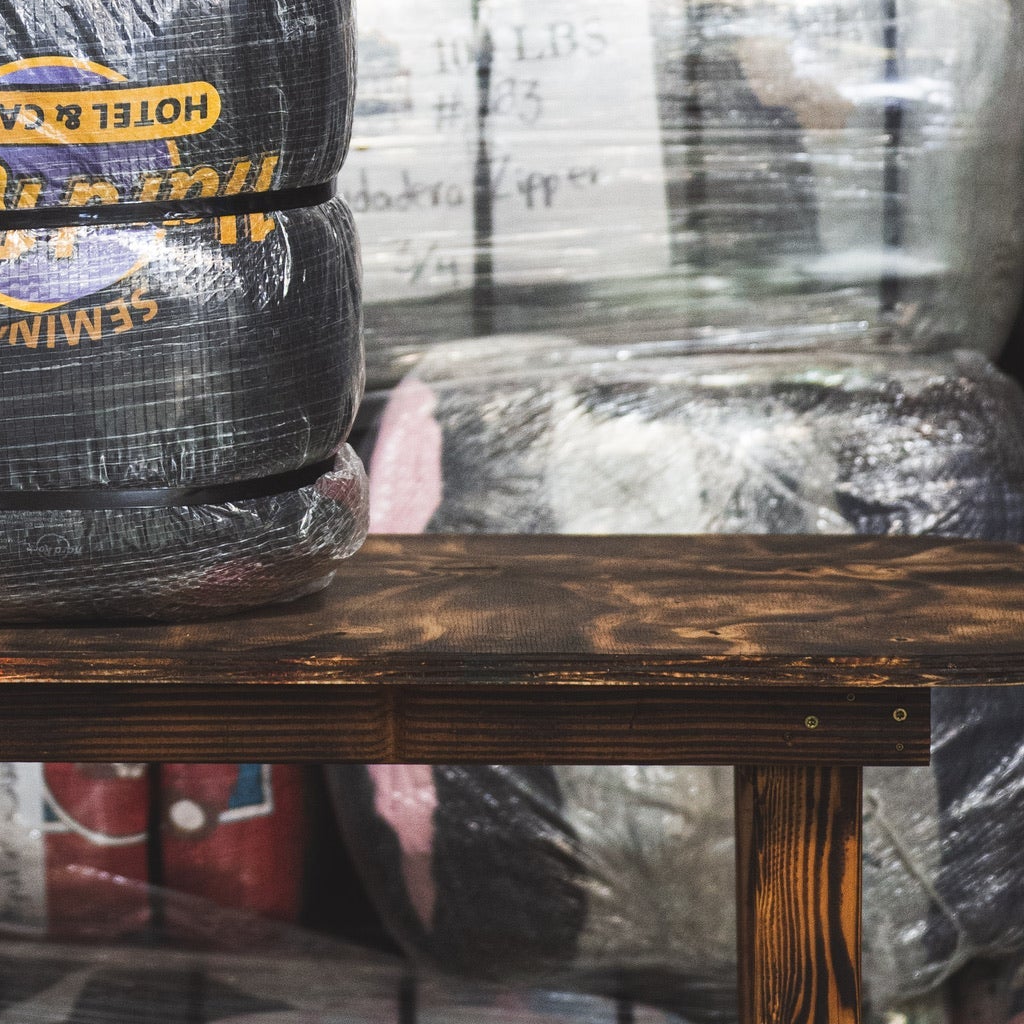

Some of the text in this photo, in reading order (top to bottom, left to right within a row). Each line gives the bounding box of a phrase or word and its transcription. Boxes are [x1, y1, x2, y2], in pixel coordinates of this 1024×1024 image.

[513, 17, 608, 61] LBS
[55, 103, 83, 130] &
[92, 92, 208, 129] HOTEL
